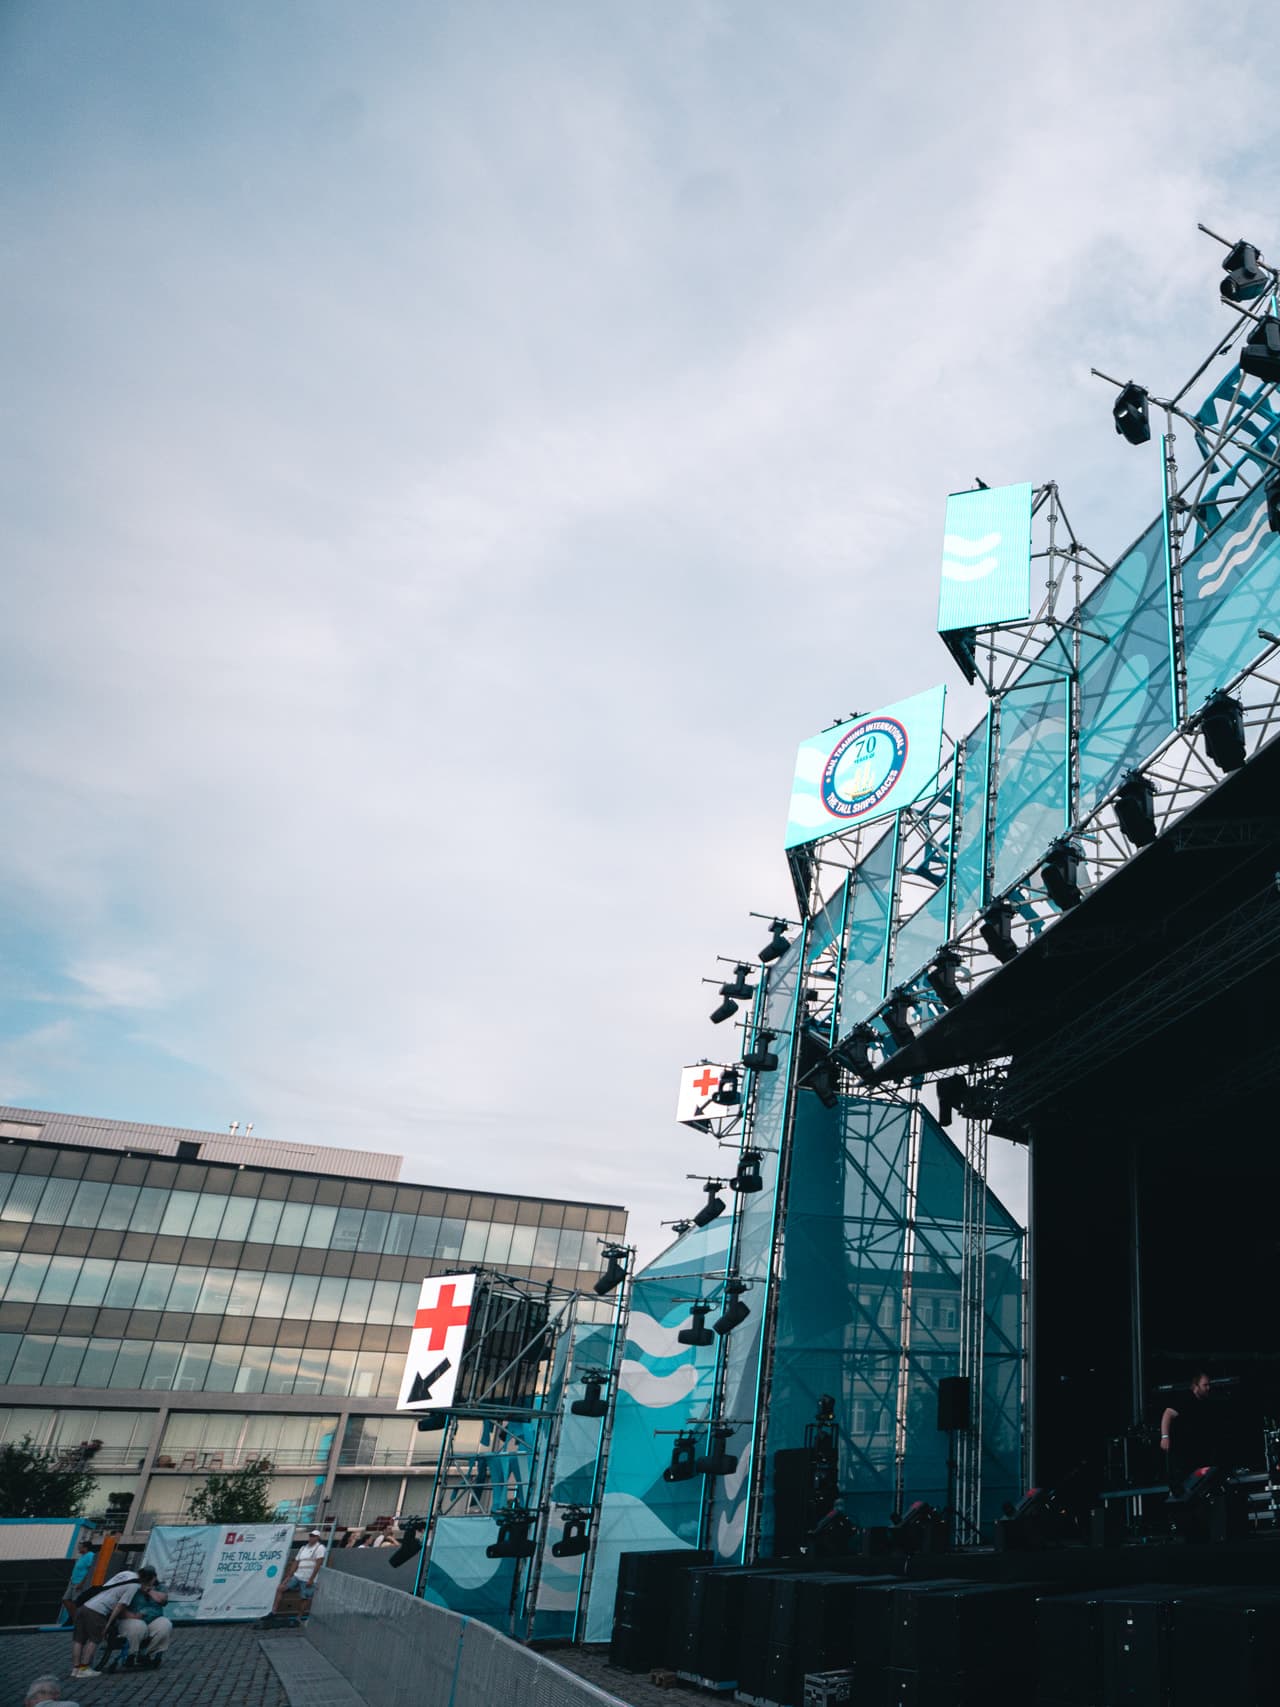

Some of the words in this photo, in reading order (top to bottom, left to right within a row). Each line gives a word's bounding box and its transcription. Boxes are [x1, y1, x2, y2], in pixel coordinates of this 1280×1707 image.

[825, 757, 837, 776] SAIL
[833, 726, 865, 759] TRAINING
[865, 721, 904, 749] INTERNATIONAL
[855, 735, 877, 758] 70
[826, 791, 837, 810] THE
[835, 803, 852, 814] TALL
[852, 794, 877, 813] SHIPS
[875, 769, 899, 800] RACES
[217, 1562, 243, 1571] RACES
[221, 1551, 236, 1561] THE
[238, 1551, 257, 1561] TALL
[258, 1550, 282, 1560] SHIPS
